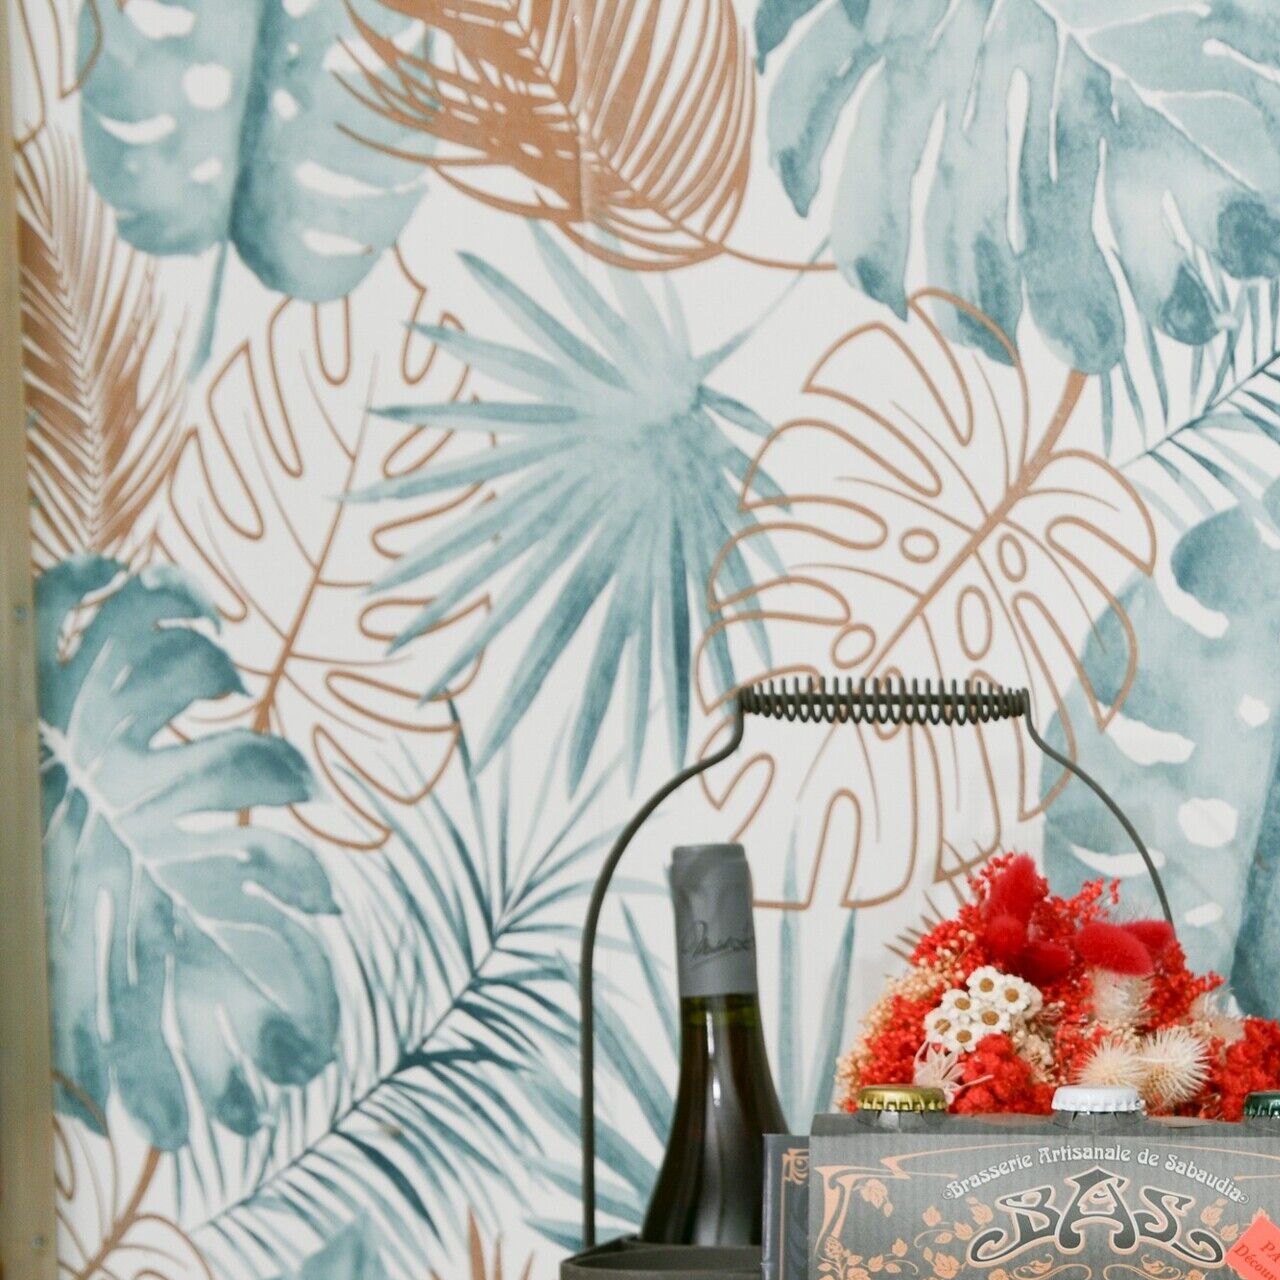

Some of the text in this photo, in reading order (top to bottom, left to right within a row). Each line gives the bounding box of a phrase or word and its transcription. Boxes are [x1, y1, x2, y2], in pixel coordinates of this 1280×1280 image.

[946, 1144, 1242, 1204] Brasserie Artisanale de Sabaudia
[966, 1165, 1228, 1268] BAS
